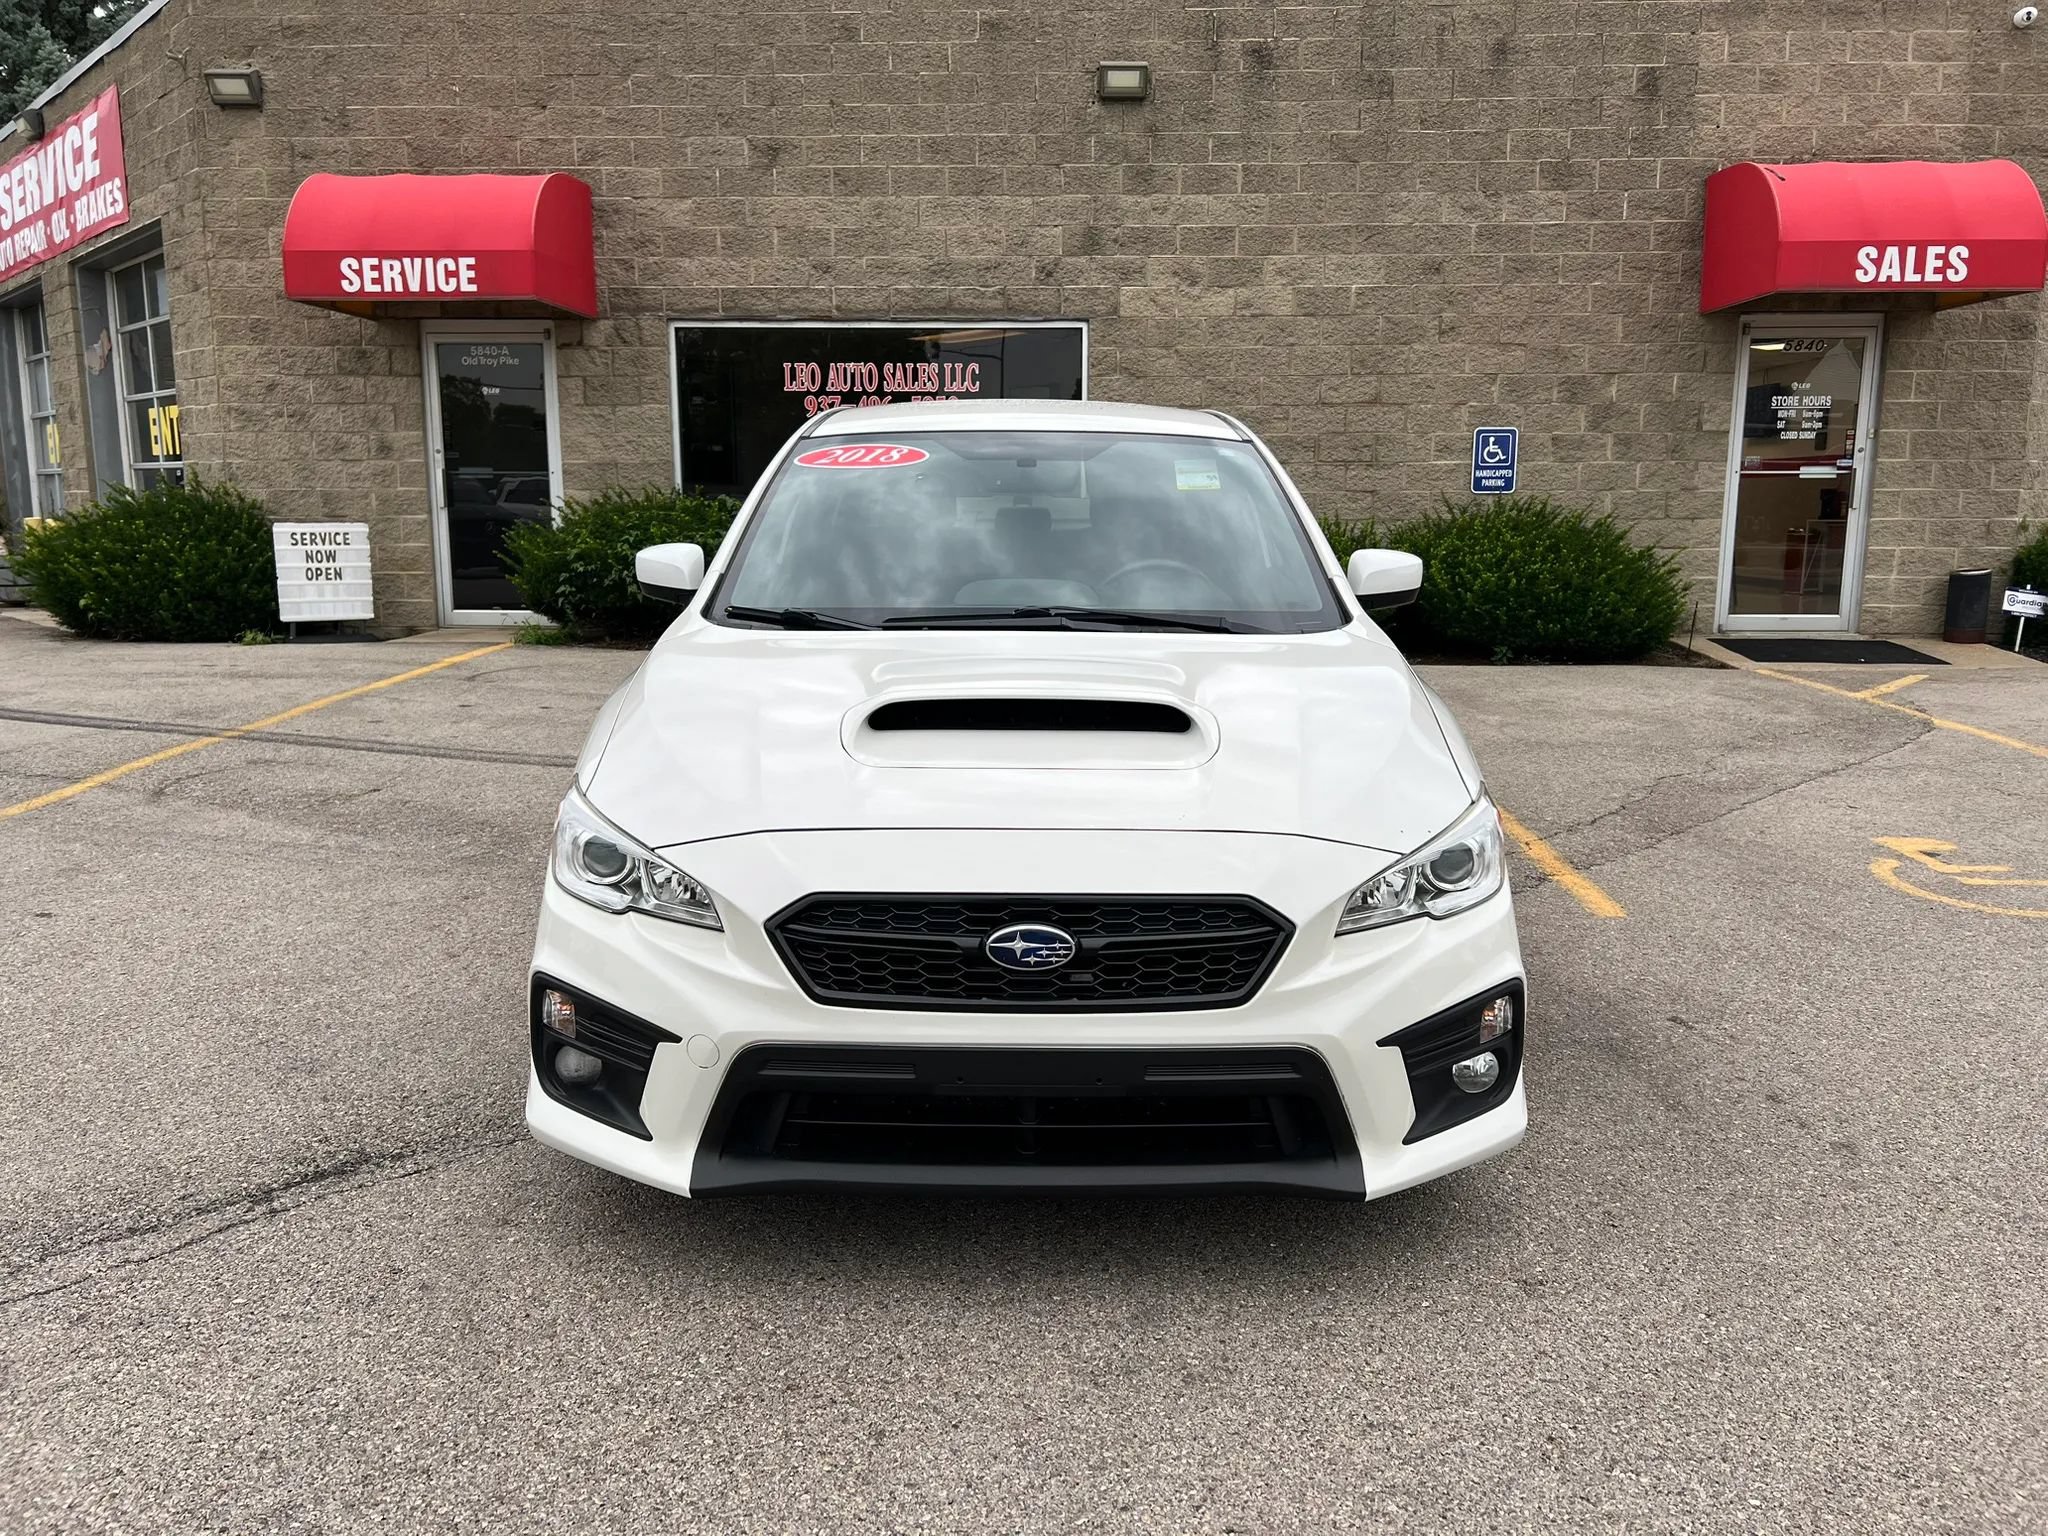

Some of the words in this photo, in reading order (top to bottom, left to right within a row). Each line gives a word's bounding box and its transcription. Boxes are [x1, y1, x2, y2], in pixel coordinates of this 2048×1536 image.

[0, 111, 100, 231] SERVICE
[14, 219, 48, 262] REPAIR
[52, 208, 70, 245] OIL
[75, 176, 124, 233] BRAKES
[1855, 245, 1970, 283] SALES
[340, 257, 478, 293] SERVICE
[470, 345, 510, 356] 5840-A
[1783, 340, 1825, 351] 5840
[461, 356, 478, 366] Old
[479, 356, 498, 368] Troy
[499, 356, 520, 366] Pike
[783, 362, 822, 393] LEO
[826, 362, 879, 393] AUTO
[883, 362, 939, 393] SALES
[944, 362, 980, 393] LLC
[1771, 395, 1800, 407] STORE
[1802, 395, 1832, 407] HOURS
[1776, 420, 1786, 429] SAT
[1780, 431, 1799, 440] CLOSED
[1799, 431, 1817, 440] SUNDAY
[814, 448, 908, 464] 2018
[1475, 469, 1513, 478] HANDICAPPED
[1481, 479, 1505, 487] PARKING
[290, 532, 351, 546] SERVICE
[305, 550, 337, 564] NOW
[305, 567, 343, 581] OPEN
